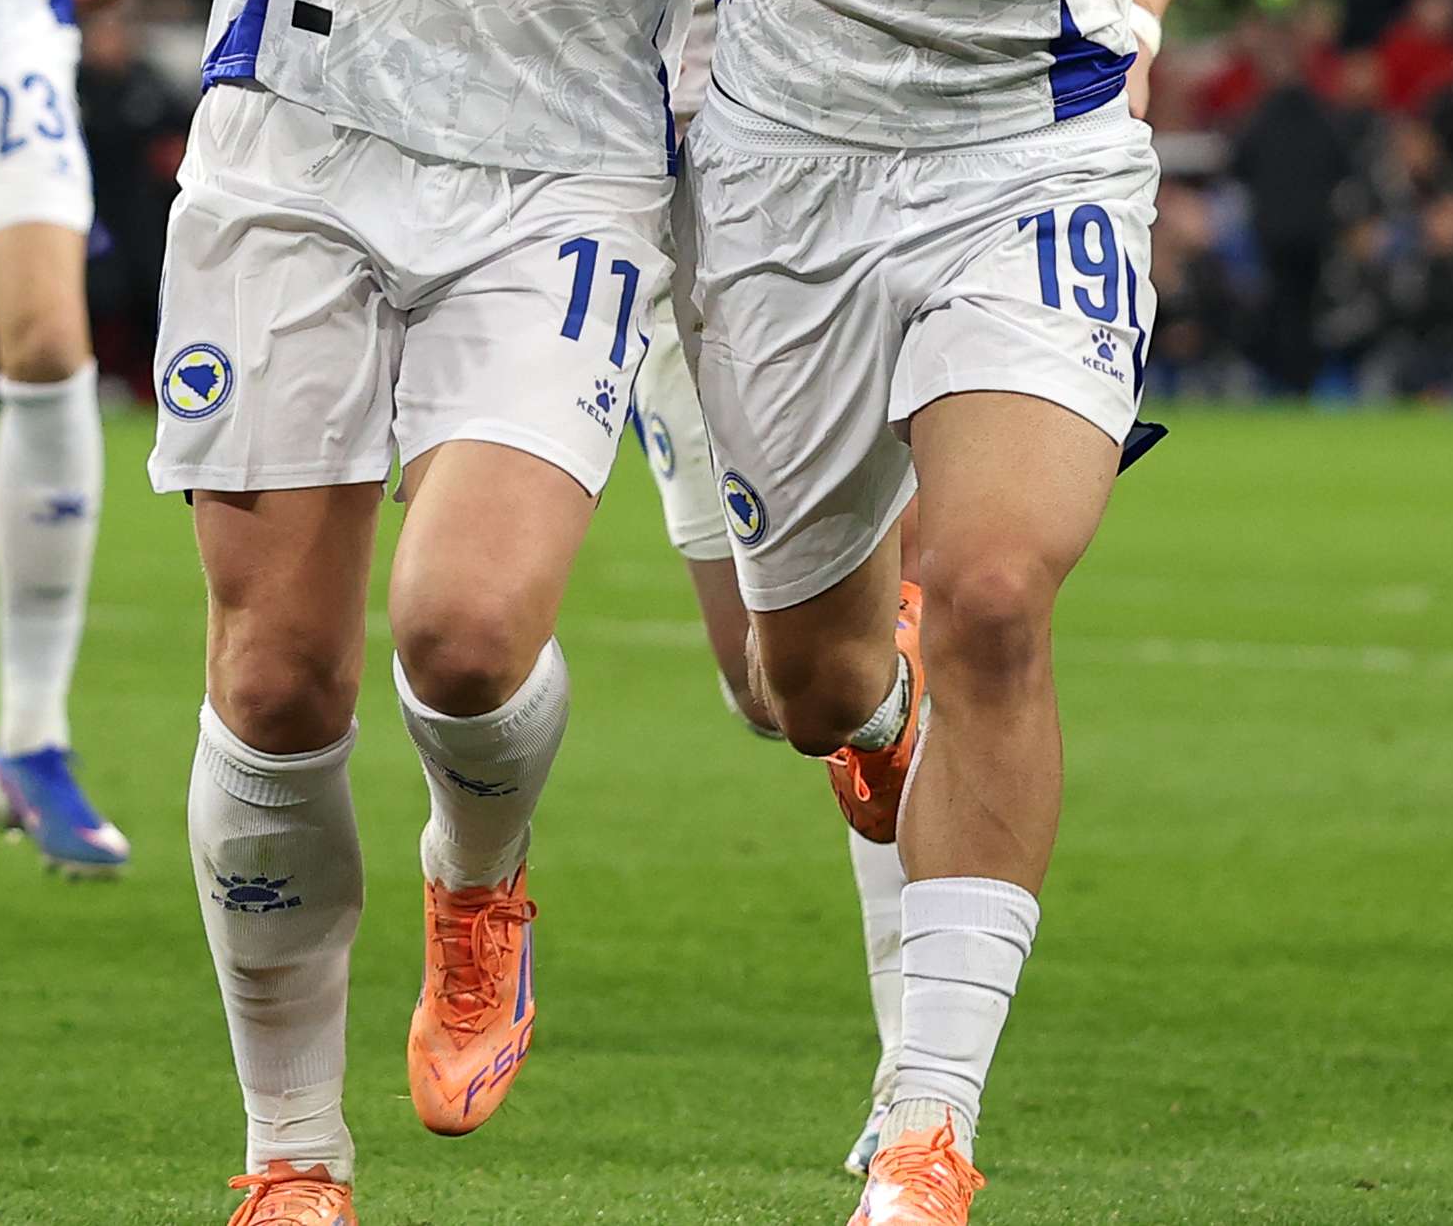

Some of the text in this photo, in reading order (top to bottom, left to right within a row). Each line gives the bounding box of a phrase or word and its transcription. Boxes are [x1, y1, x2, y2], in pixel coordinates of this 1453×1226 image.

[558, 237, 641, 370] 11
[1017, 203, 1119, 323] 19
[1082, 355, 1126, 384] KELME
[576, 396, 614, 439] KELME
